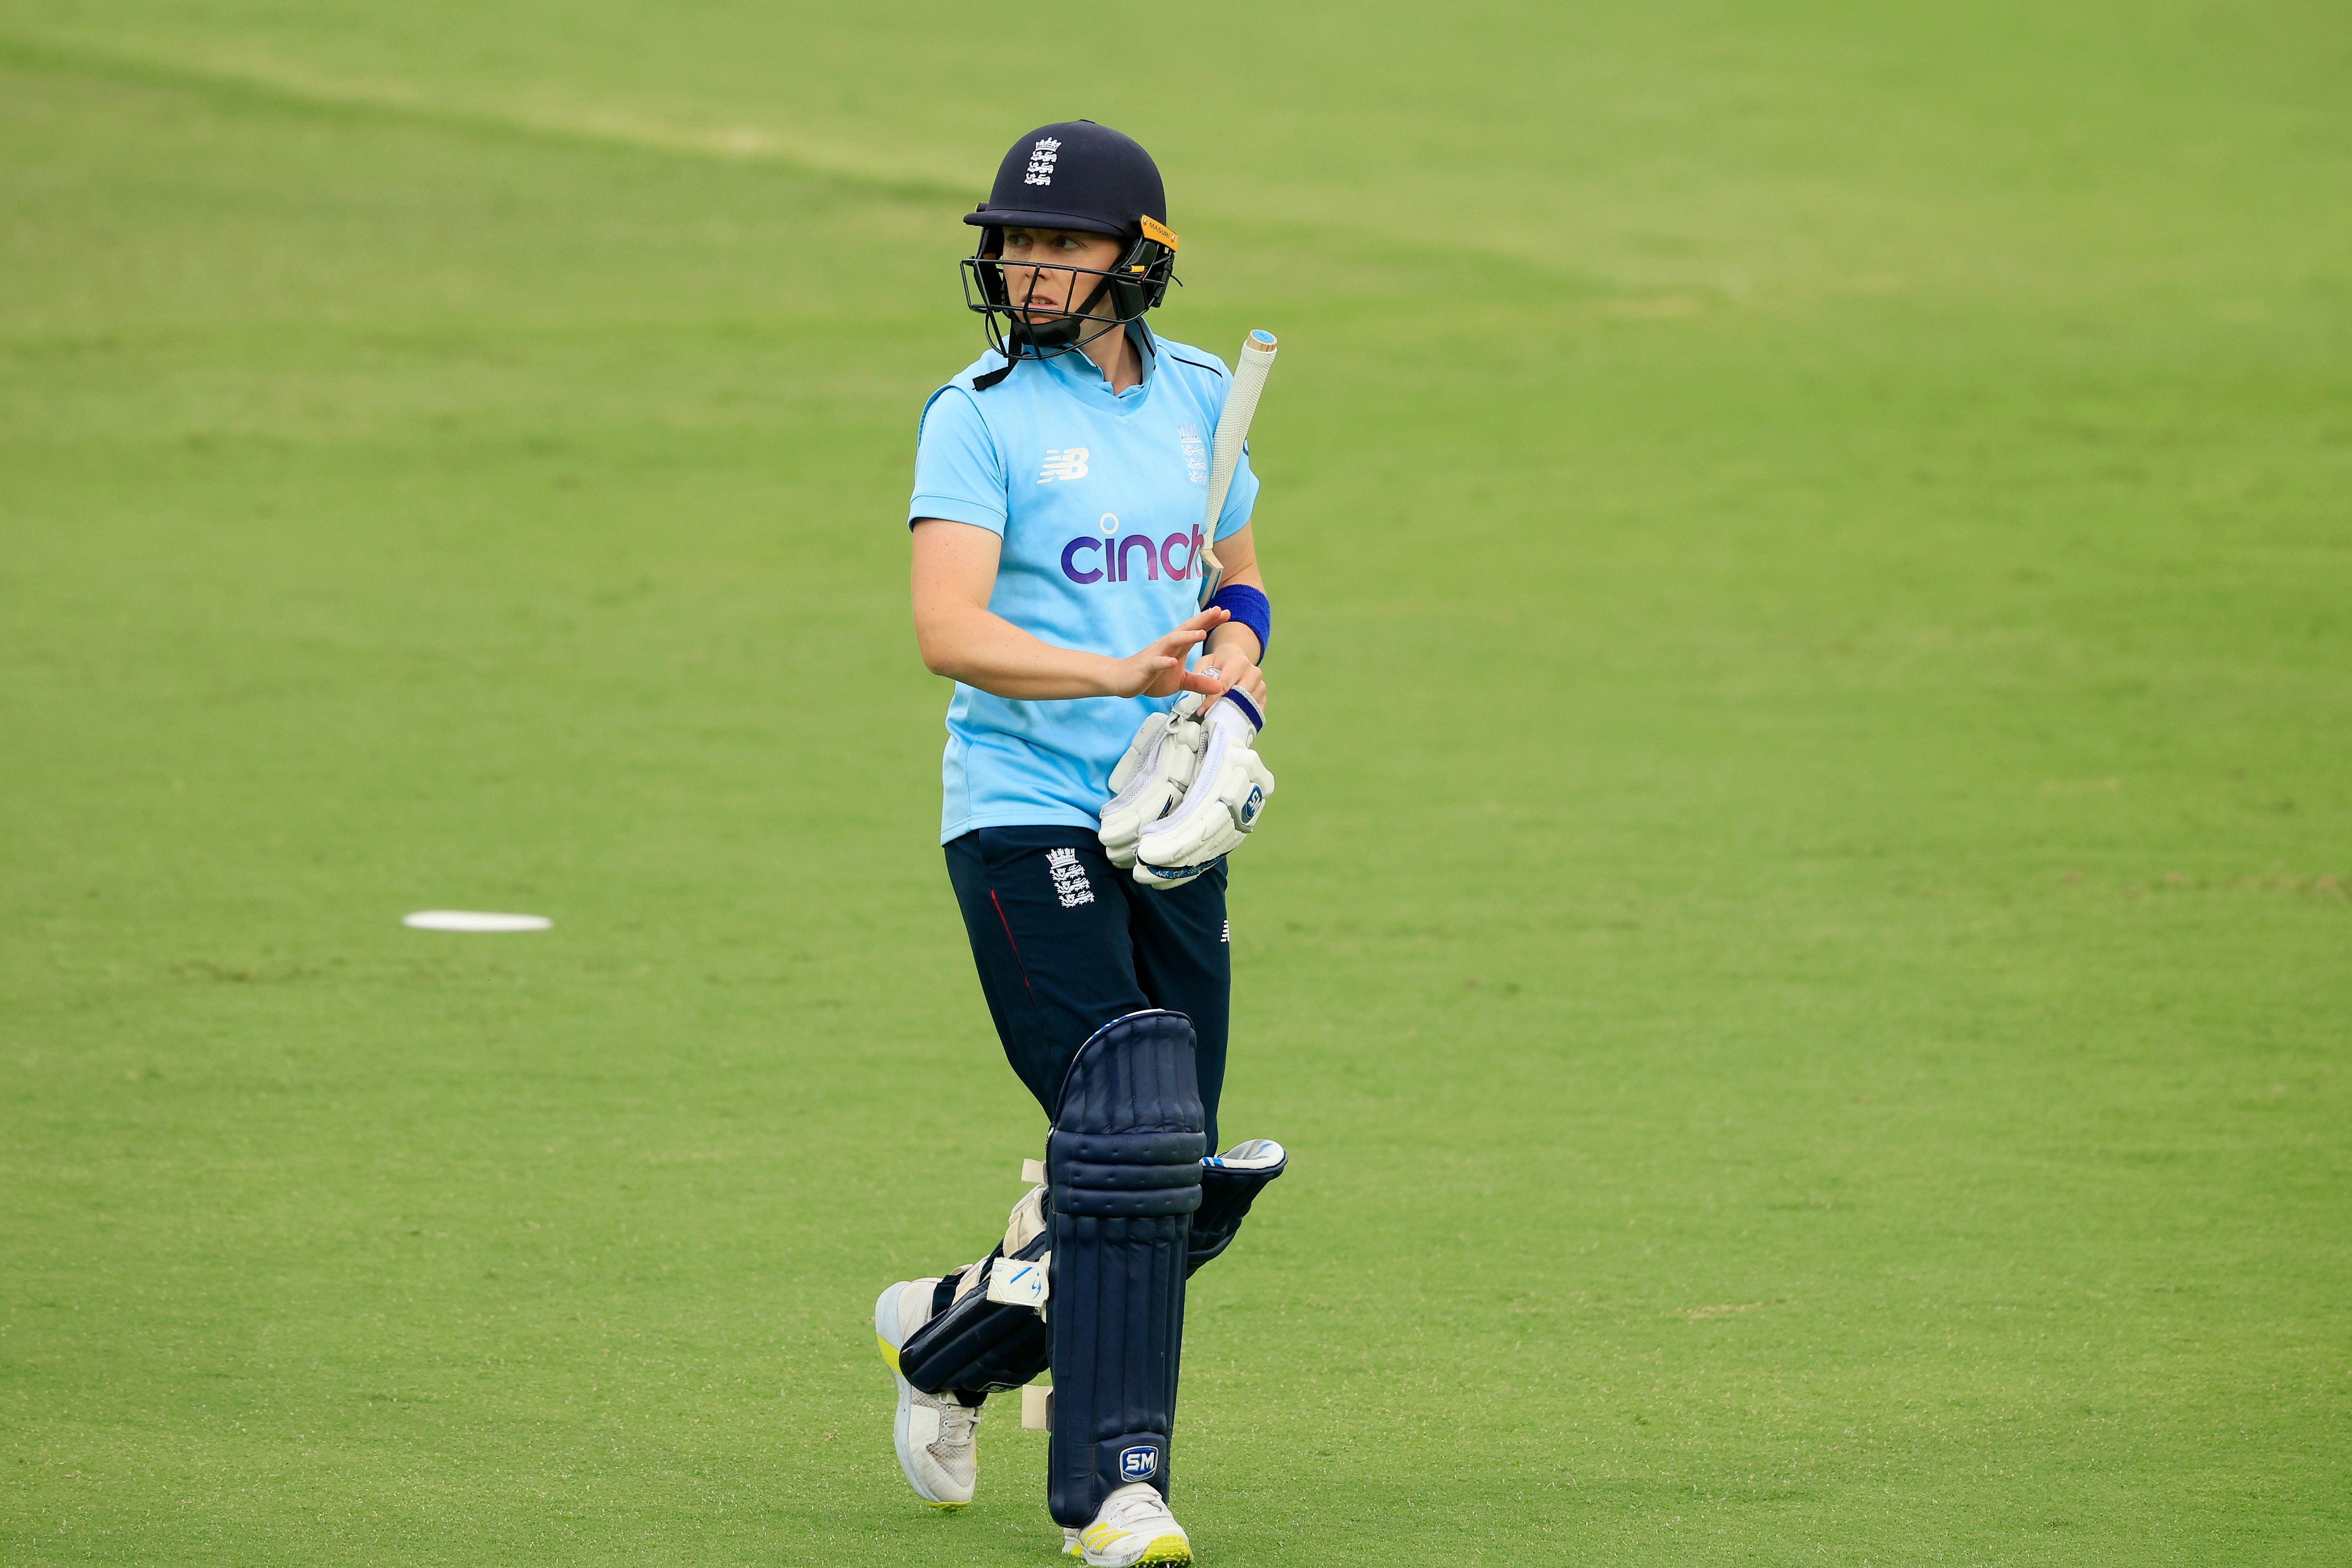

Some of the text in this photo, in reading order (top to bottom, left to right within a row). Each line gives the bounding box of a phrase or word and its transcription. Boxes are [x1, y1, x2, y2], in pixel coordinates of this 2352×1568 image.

[1149, 222, 1170, 238] MASURI
[1036, 447, 1089, 484] NB
[1061, 512, 1204, 584] cinch
[1248, 790, 1261, 815] SM
[1125, 1452, 1154, 1471] SM
